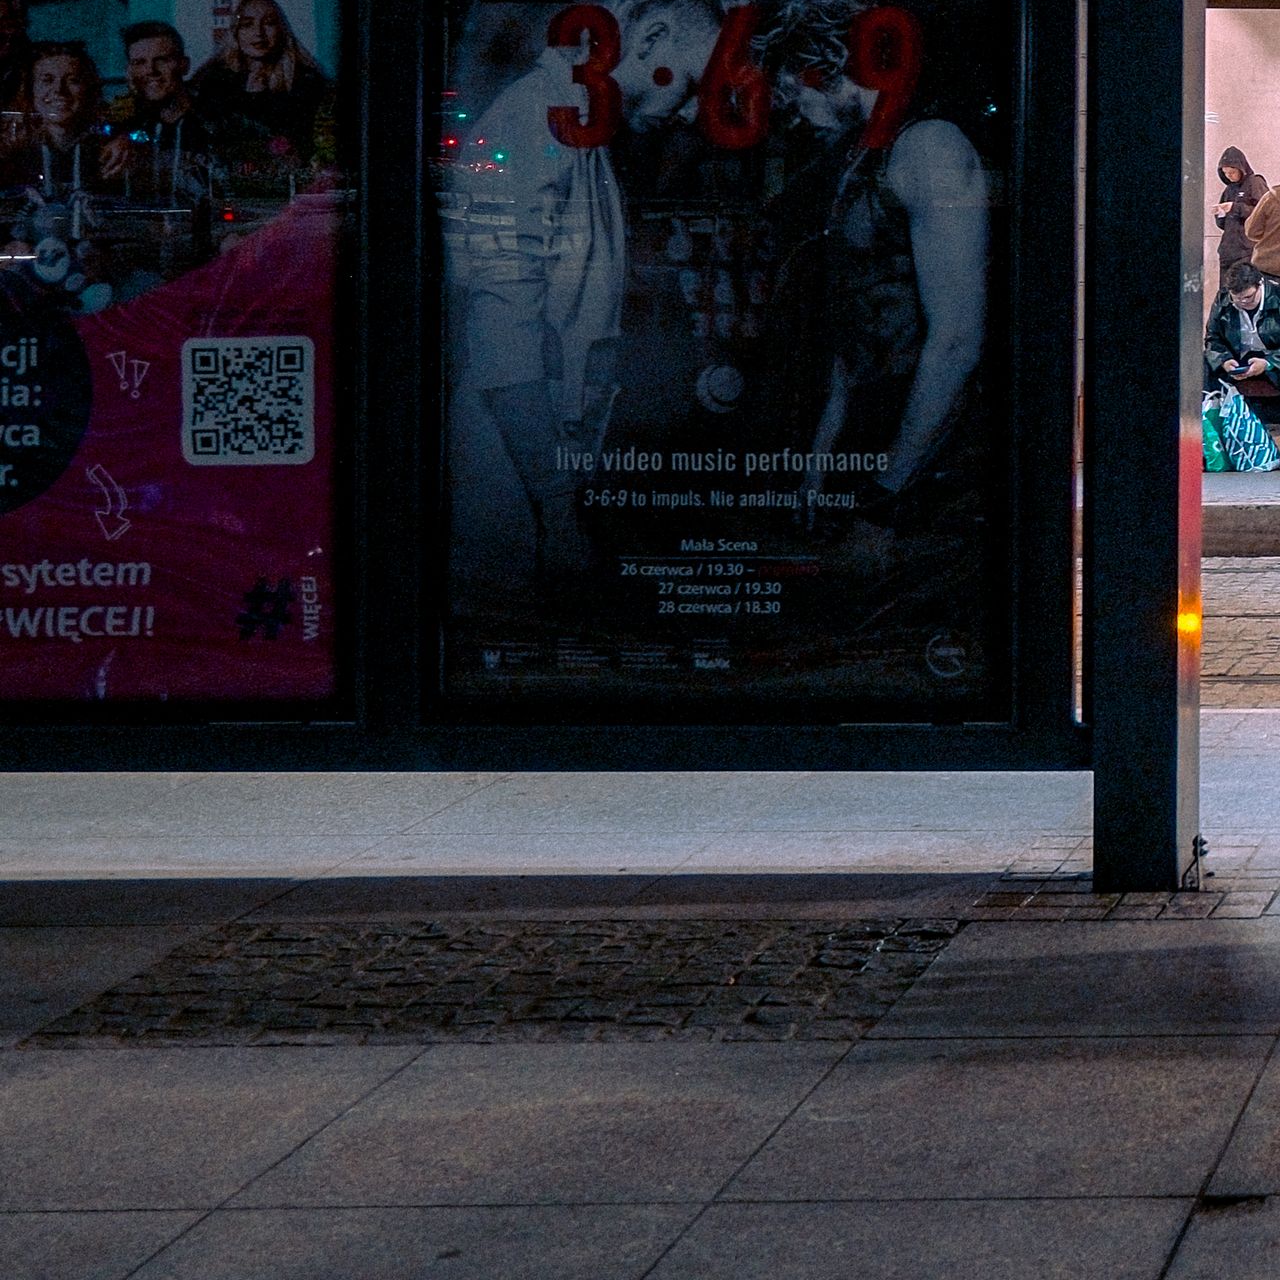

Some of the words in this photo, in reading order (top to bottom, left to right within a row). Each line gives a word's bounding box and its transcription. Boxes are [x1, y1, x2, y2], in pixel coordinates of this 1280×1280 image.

[556, 447, 594, 472] live
[602, 446, 663, 471] video
[671, 448, 737, 472] music
[744, 447, 889, 477] performance
[631, 490, 646, 507] to
[651, 489, 705, 510] impuls.
[710, 489, 734, 507] Nie
[738, 489, 801, 510] analizuj.
[807, 489, 860, 510] Poczuj.
[718, 538, 758, 553] Scena
[620, 563, 637, 577] 26
[640, 565, 693, 577] czerwca
[707, 563, 744, 577] 19.30
[658, 582, 674, 596] 27
[677, 584, 731, 597] czerwca
[745, 582, 782, 596] 19.30
[302, 577, 322, 640] WIĘCEJ
[658, 601, 674, 615] 28
[677, 603, 731, 615] czerwca
[745, 601, 781, 615] 18.30
[0, 606, 155, 643] WIĘCEJ!
